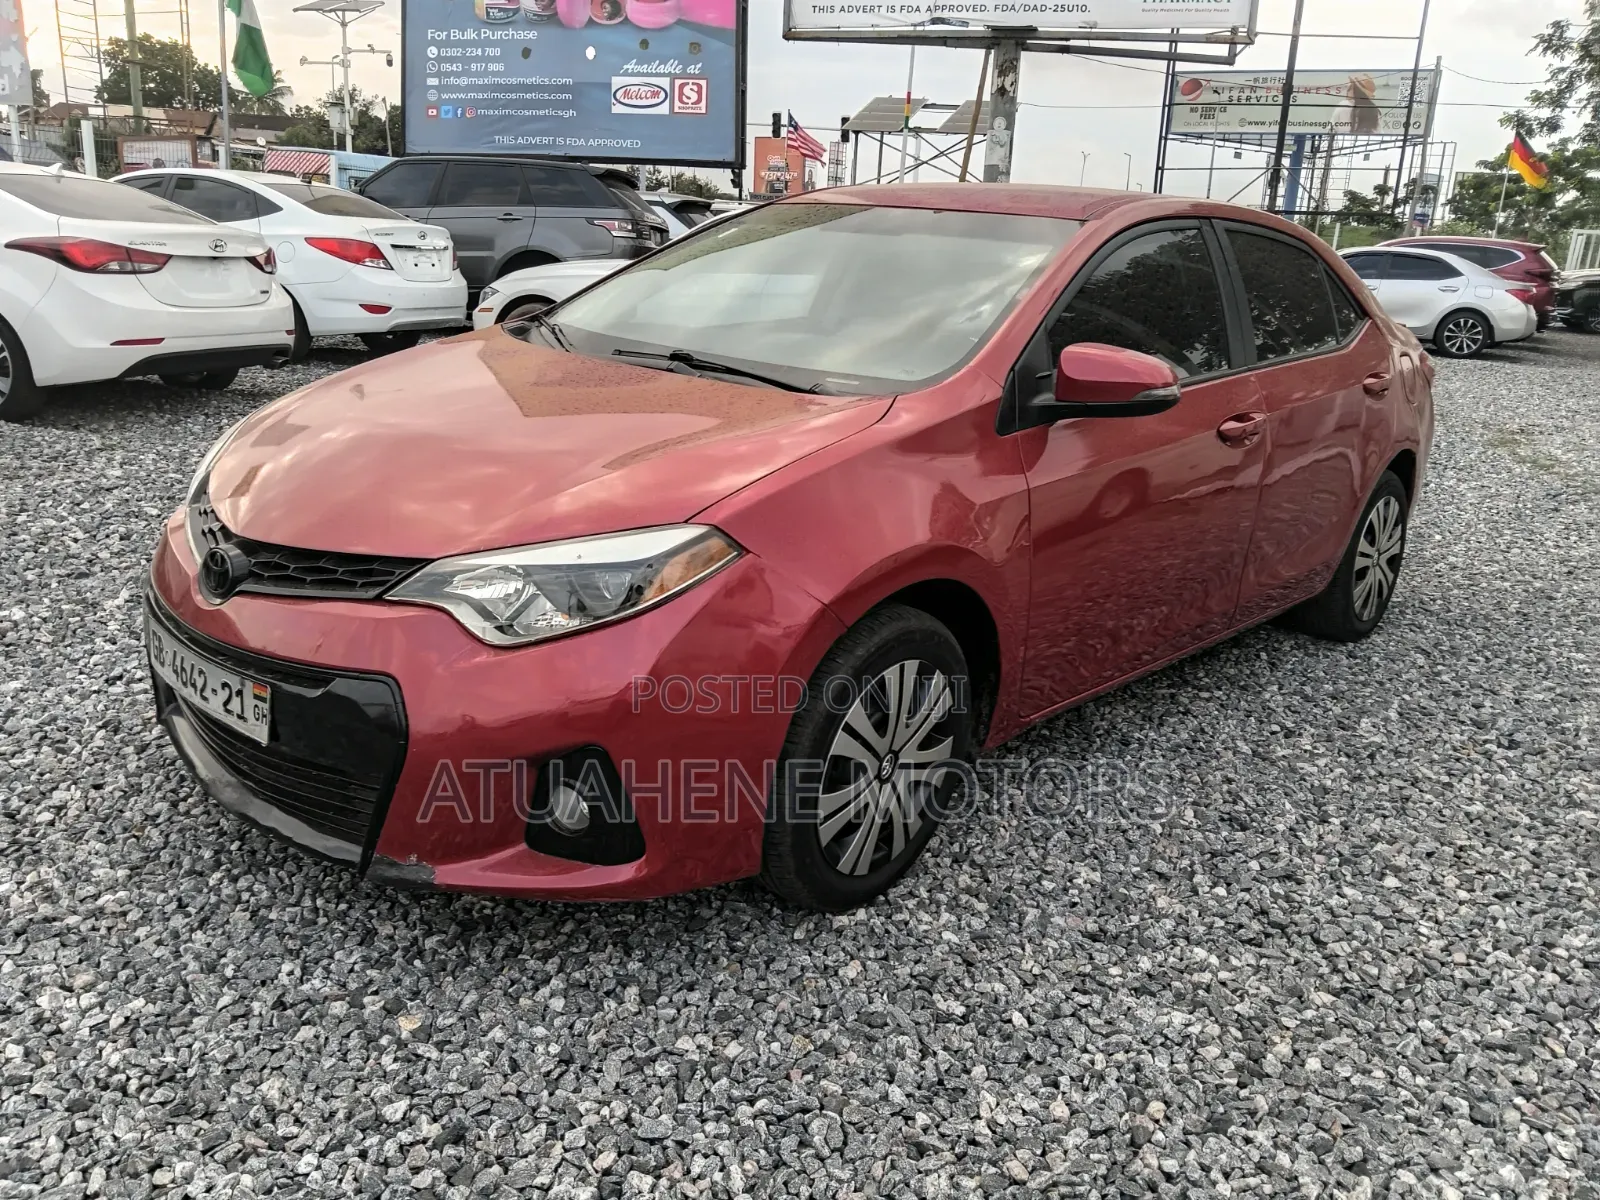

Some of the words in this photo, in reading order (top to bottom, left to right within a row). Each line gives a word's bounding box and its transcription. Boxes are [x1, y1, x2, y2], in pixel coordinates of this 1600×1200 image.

[812, 5, 836, 14] THIS
[839, 5, 883, 14] ADVERT
[886, 5, 896, 14] IS
[900, 5, 921, 14] FDA
[925, 4, 990, 14] APPROVED.
[427, 29, 447, 40] For
[450, 28, 478, 40] Bulk
[481, 28, 538, 40] Purchase
[440, 48, 482, 56] 0302-234
[485, 48, 501, 56] 700
[440, 63, 462, 72] 0543
[471, 63, 485, 72] 917
[487, 63, 505, 72] 906
[619, 58, 684, 74] Available
[686, 62, 703, 75] at
[441, 76, 573, 87] info@maximcosmetics.com
[441, 91, 573, 100] www.maximcosmetics.com
[1265, 86, 1342, 95] BUINESS
[1228, 95, 1298, 103] SERVICS
[477, 107, 577, 118] maximcosmeticsgh
[1247, 119, 1352, 130] www.yifbusinessgh.com
[494, 136, 515, 144] THIS
[517, 136, 554, 145] ADVERT
[556, 137, 565, 145] IS
[566, 137, 586, 146] FDA
[587, 138, 641, 148] APPROVED
[171, 648, 248, 723] 4642-21
[253, 703, 268, 726] GH
